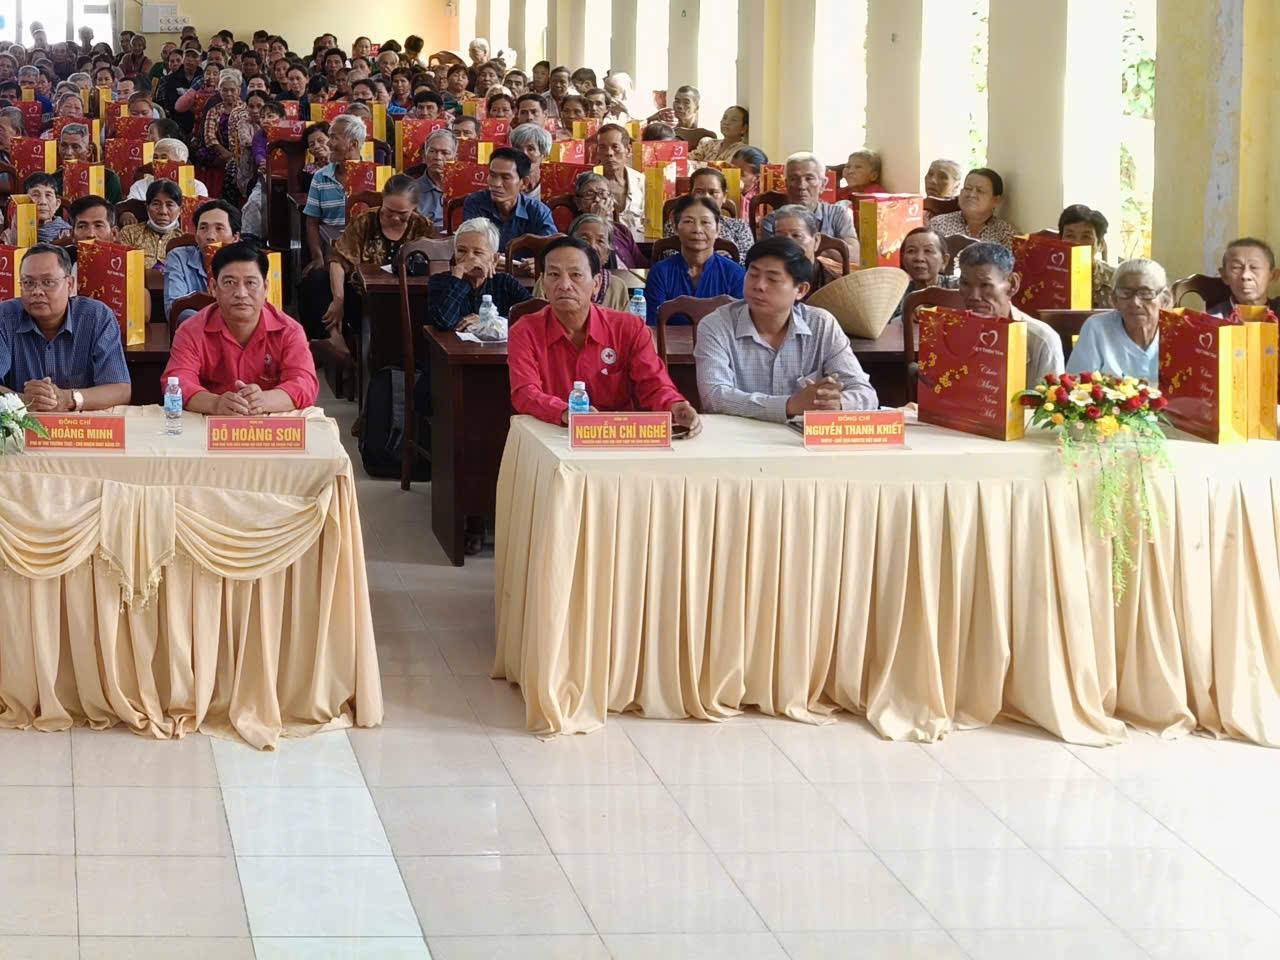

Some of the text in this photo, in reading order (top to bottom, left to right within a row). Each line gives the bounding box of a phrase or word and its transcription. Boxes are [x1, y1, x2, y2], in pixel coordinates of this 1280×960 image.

[51, 426, 84, 439] HOÀNG
[87, 428, 113, 440] MINH
[212, 424, 301, 441] ĐỖ HOÀNG SƠN
[575, 421, 616, 439] NGUYỄN
[619, 422, 636, 439] CHÍ
[806, 421, 903, 435] NGUYỄN THANH KHIẾT
